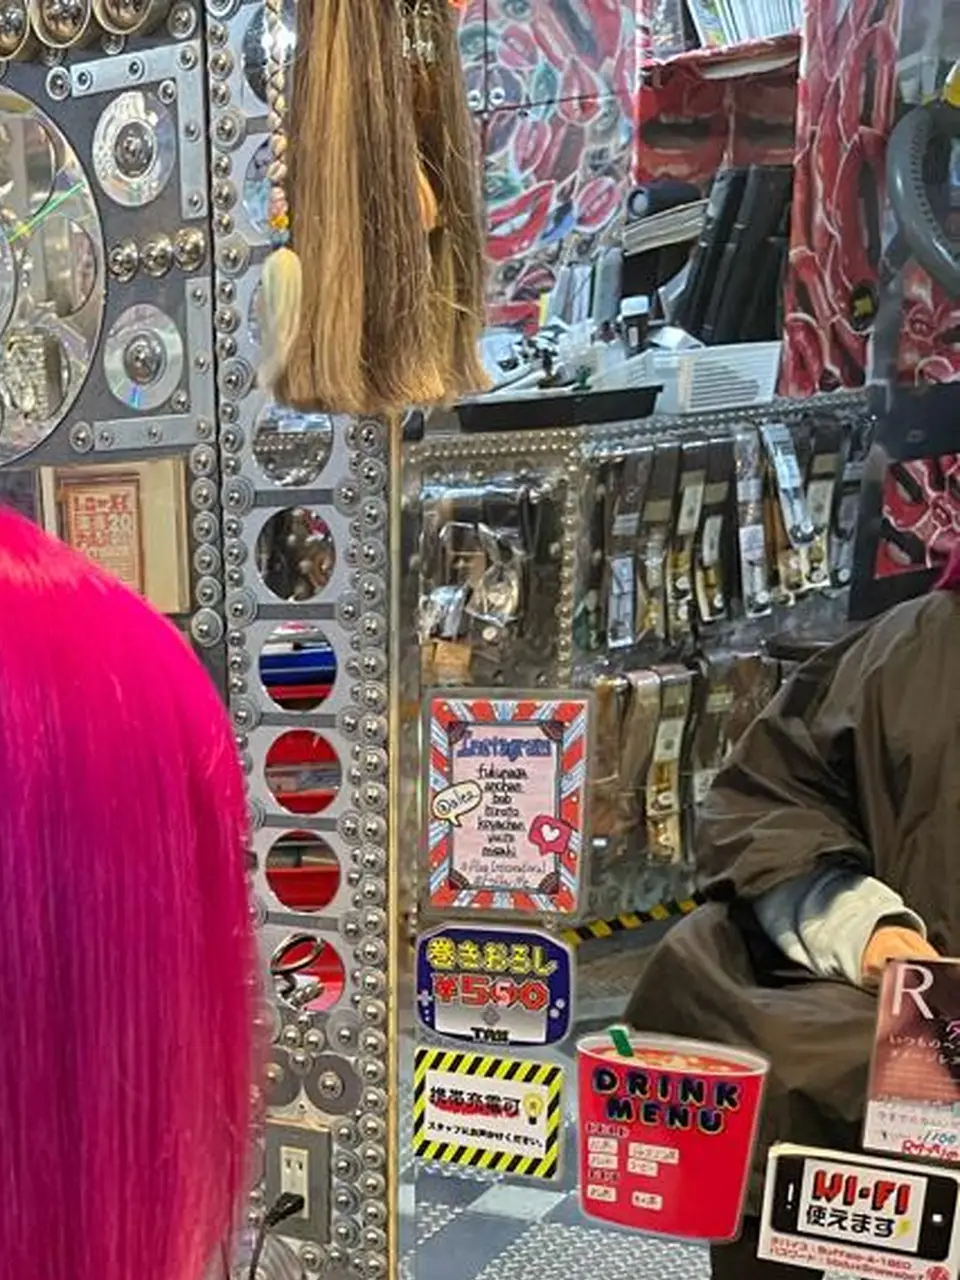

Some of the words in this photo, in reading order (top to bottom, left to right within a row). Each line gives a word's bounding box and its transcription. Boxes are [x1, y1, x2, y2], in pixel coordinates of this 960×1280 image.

[456, 735, 552, 762] Instagram
[891, 963, 935, 1019] R
[593, 1066, 740, 1110] DRINK
[606, 1097, 724, 1134] MENU
[812, 1169, 911, 1215] WI-FI
[806, 1204, 895, 1238] 使えます
